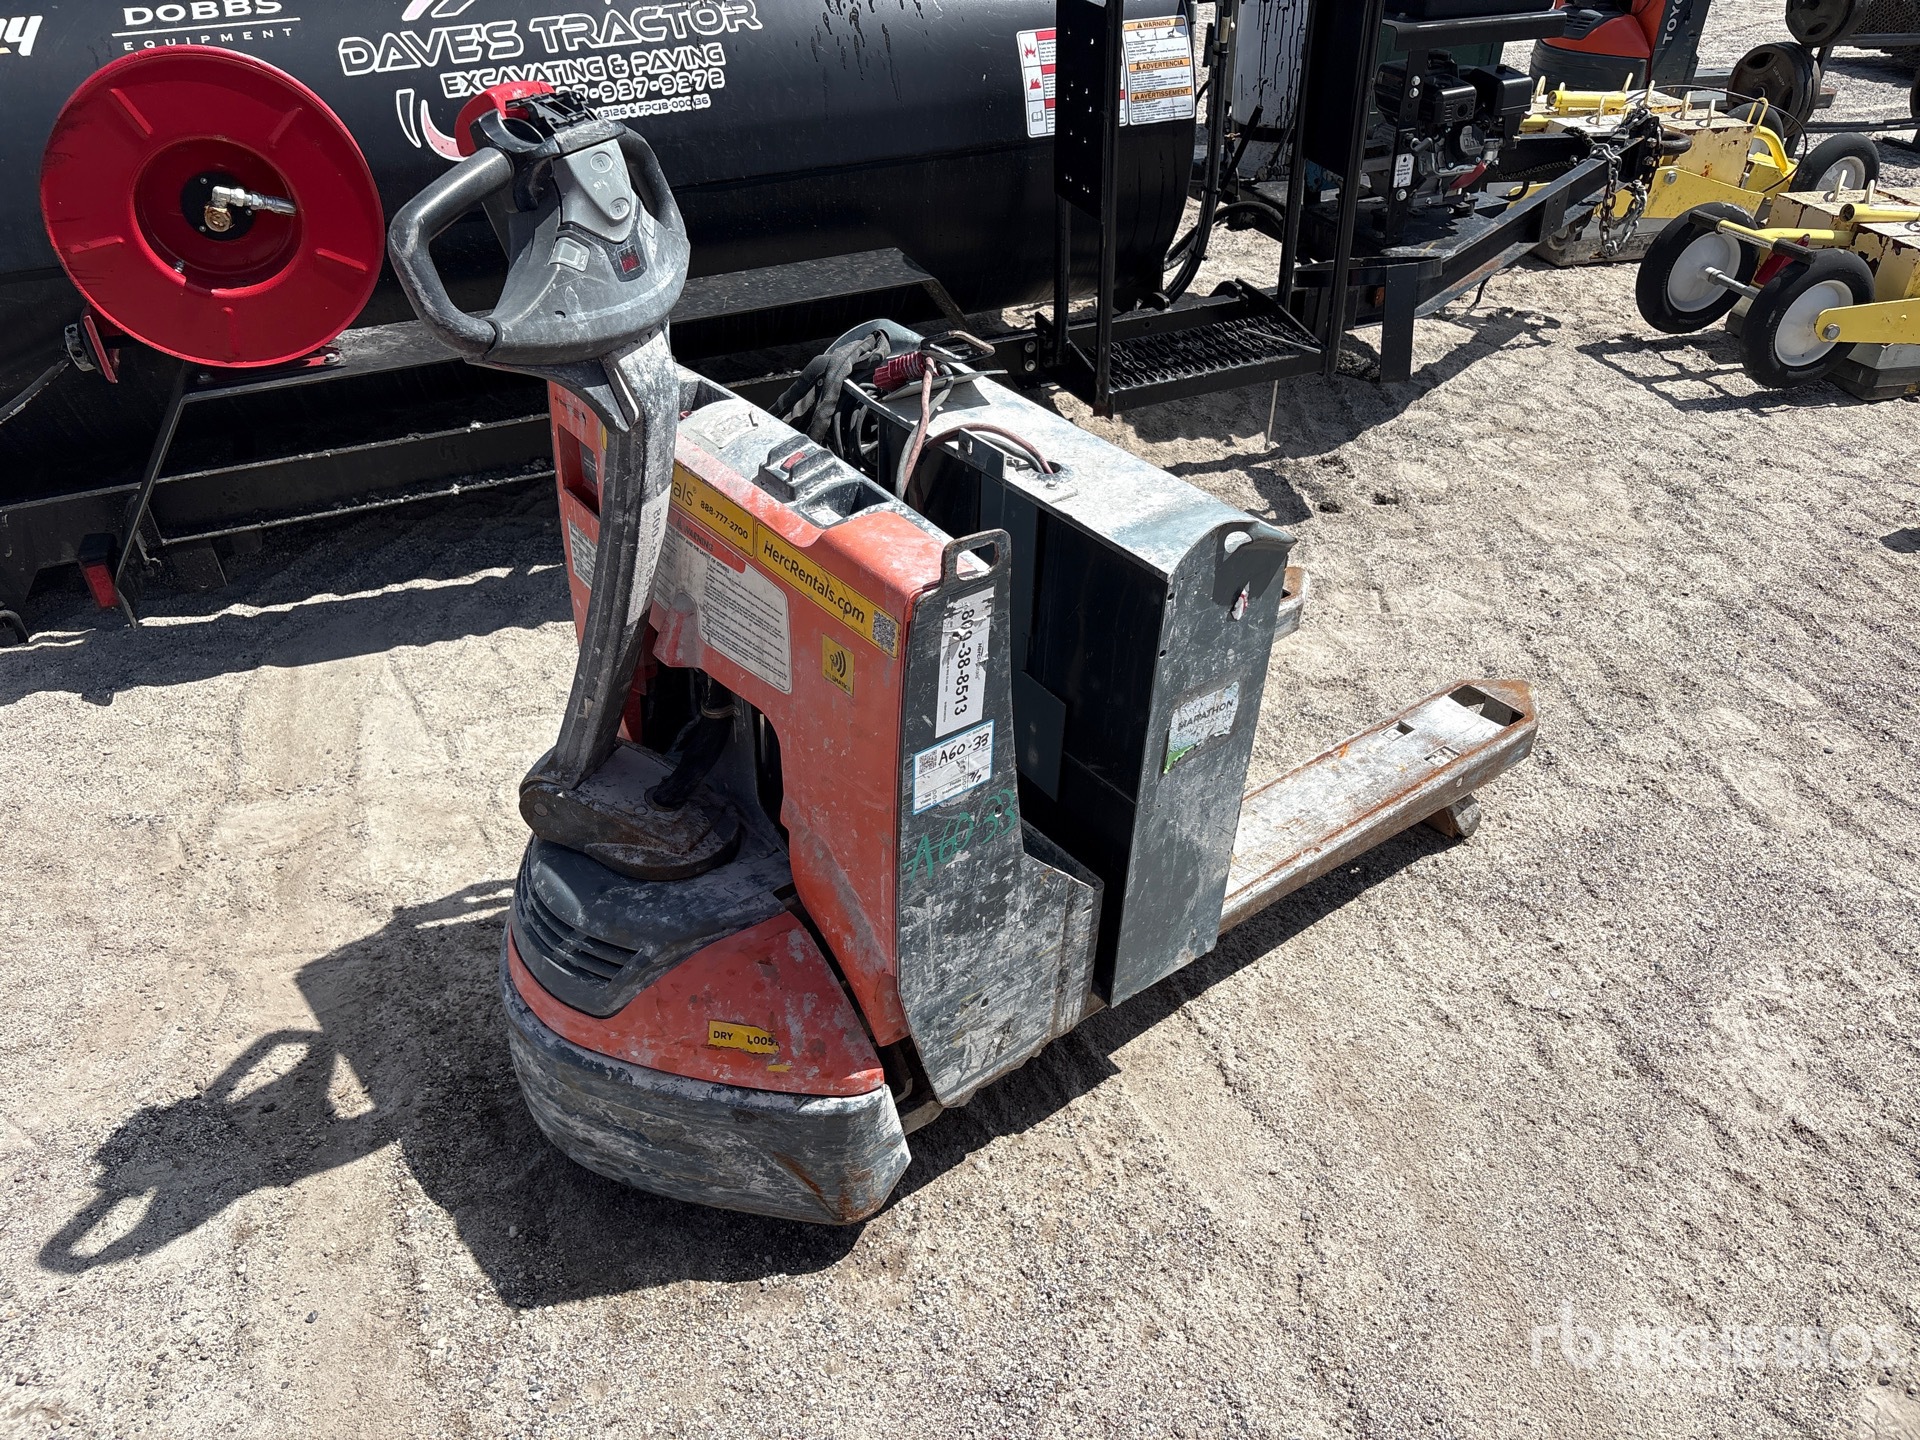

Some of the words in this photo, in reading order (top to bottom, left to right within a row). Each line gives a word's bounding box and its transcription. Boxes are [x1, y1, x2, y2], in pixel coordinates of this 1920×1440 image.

[123, 0, 283, 26] DOBBS
[1142, 20, 1171, 28] WARNING
[123, 28, 293, 51] EQUIPMENT
[338, 20, 525, 76] DAVE'S
[529, 0, 763, 54] TRACTOR
[440, 54, 608, 98] EXCAVATING
[608, 53, 630, 78] &
[632, 42, 727, 76] PAVING
[1142, 59, 1184, 70] ADVERTENCIA
[1140, 88, 1188, 99] AVERTISSEMENT
[700, 499, 749, 540] 888-777-2700
[684, 526, 714, 552] WARNING
[764, 542, 865, 624] HercRentals.com
[1177, 699, 1234, 732] MARATHON
[938, 732, 990, 766] A60-33
[713, 1030, 734, 1041] DRY
